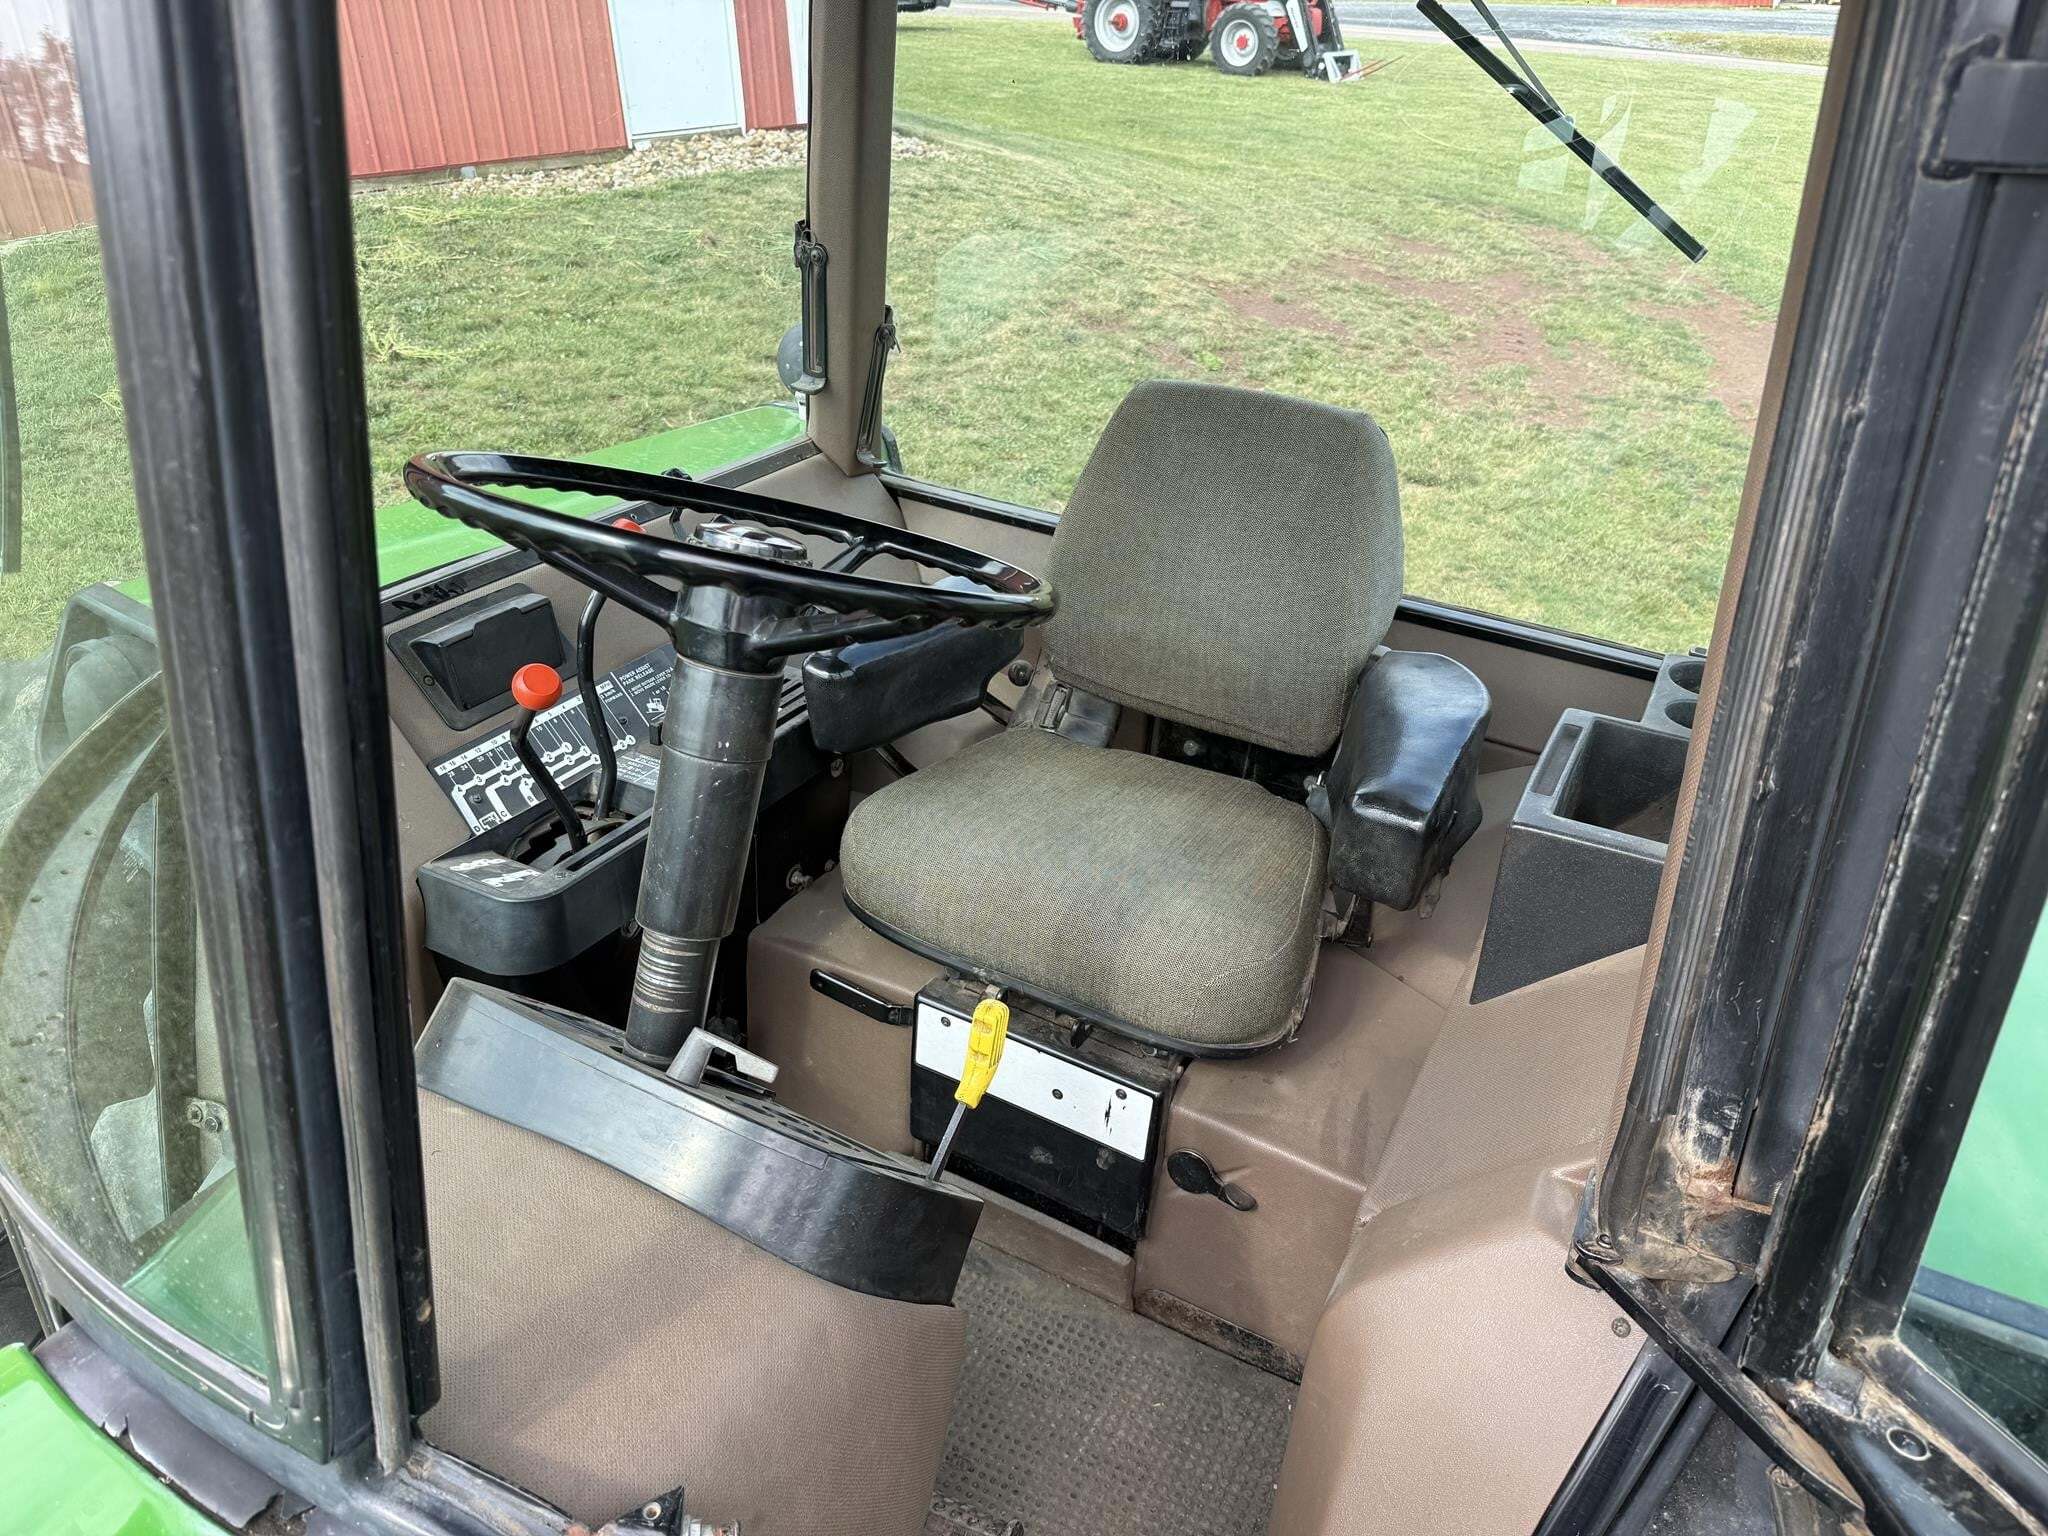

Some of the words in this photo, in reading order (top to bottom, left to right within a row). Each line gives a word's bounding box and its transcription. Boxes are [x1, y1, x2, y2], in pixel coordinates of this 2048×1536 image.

[619, 670, 636, 681] POWER
[635, 662, 650, 673] ASSIST
[622, 677, 635, 686] PARK
[635, 667, 654, 679] RELEASE
